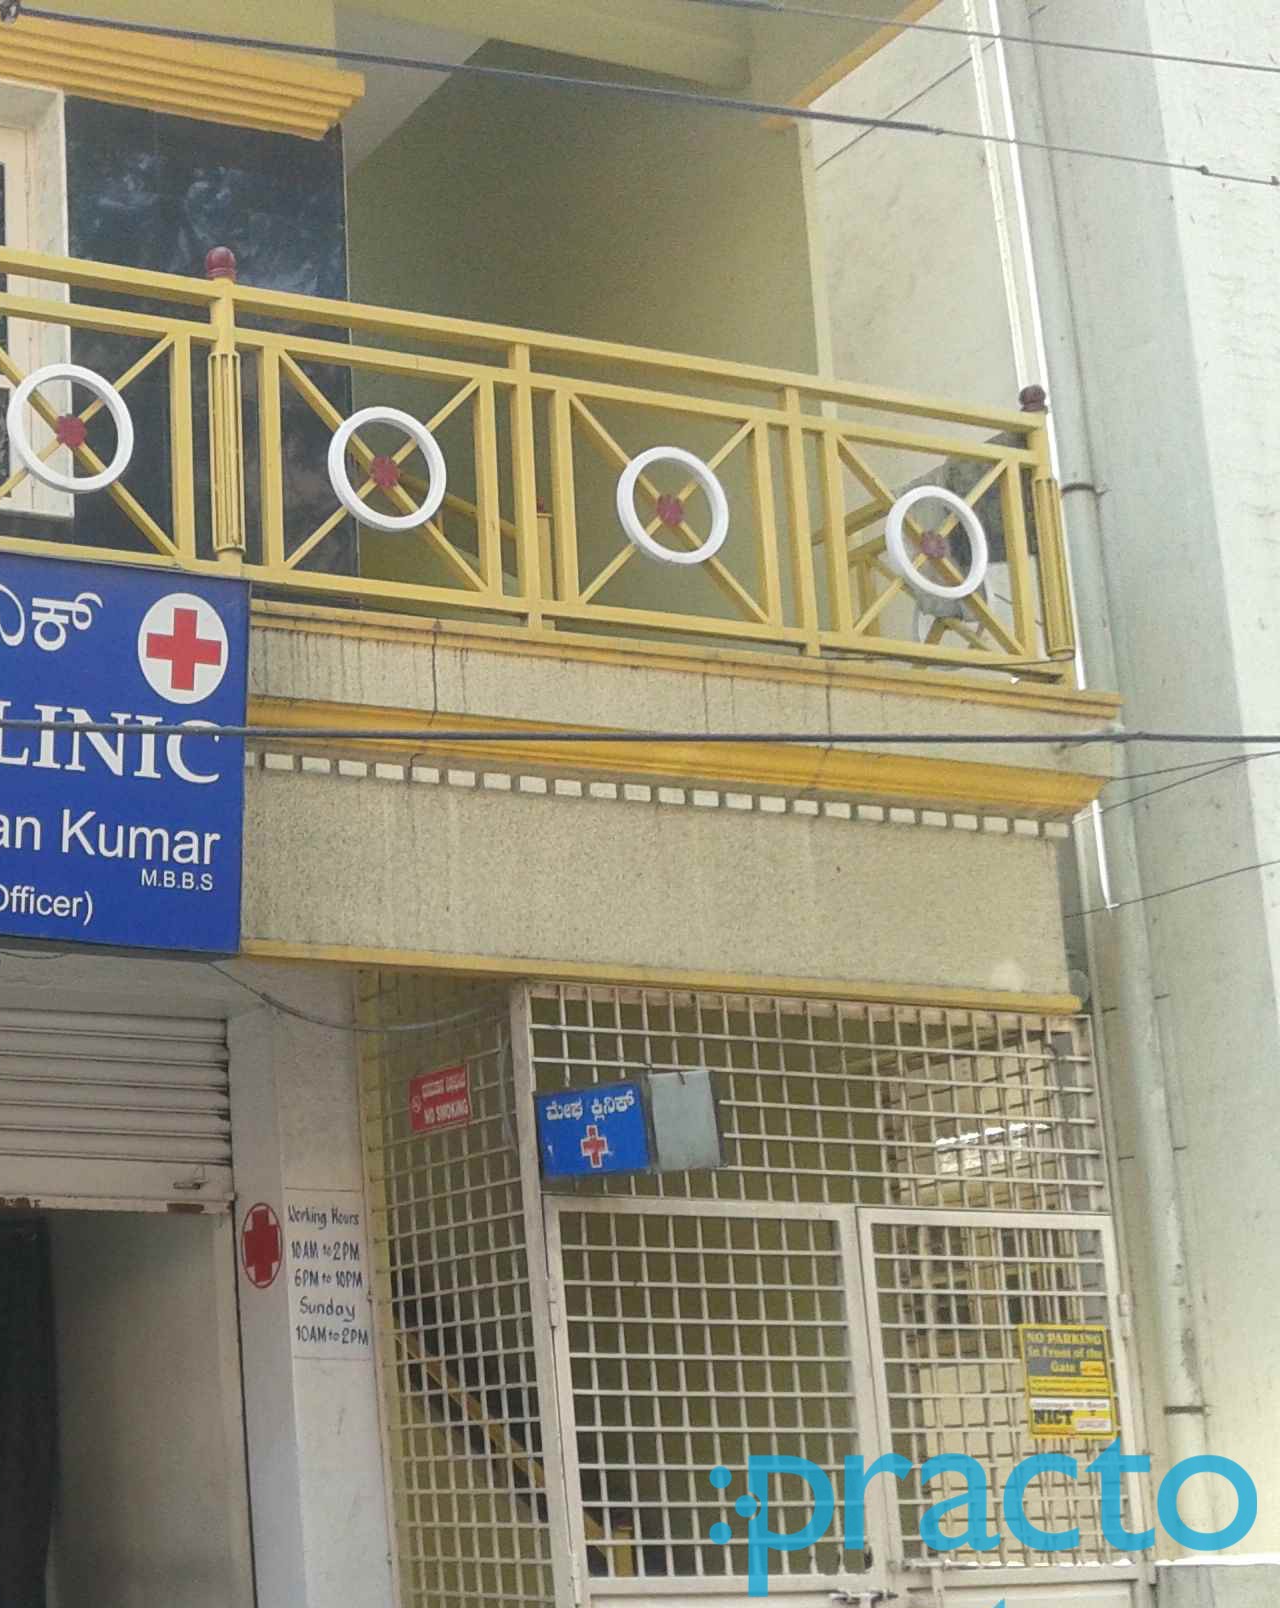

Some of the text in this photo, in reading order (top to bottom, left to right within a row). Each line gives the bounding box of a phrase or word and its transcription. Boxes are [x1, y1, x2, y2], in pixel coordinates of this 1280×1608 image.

[61, 808, 221, 866] Kumar
[140, 868, 214, 891] M.B.B.S
[287, 1203, 360, 1231] Working Hours
[322, 1272, 332, 1284] to
[299, 1295, 356, 1323] Sunday
[1047, 1331, 1103, 1346] PARKING
